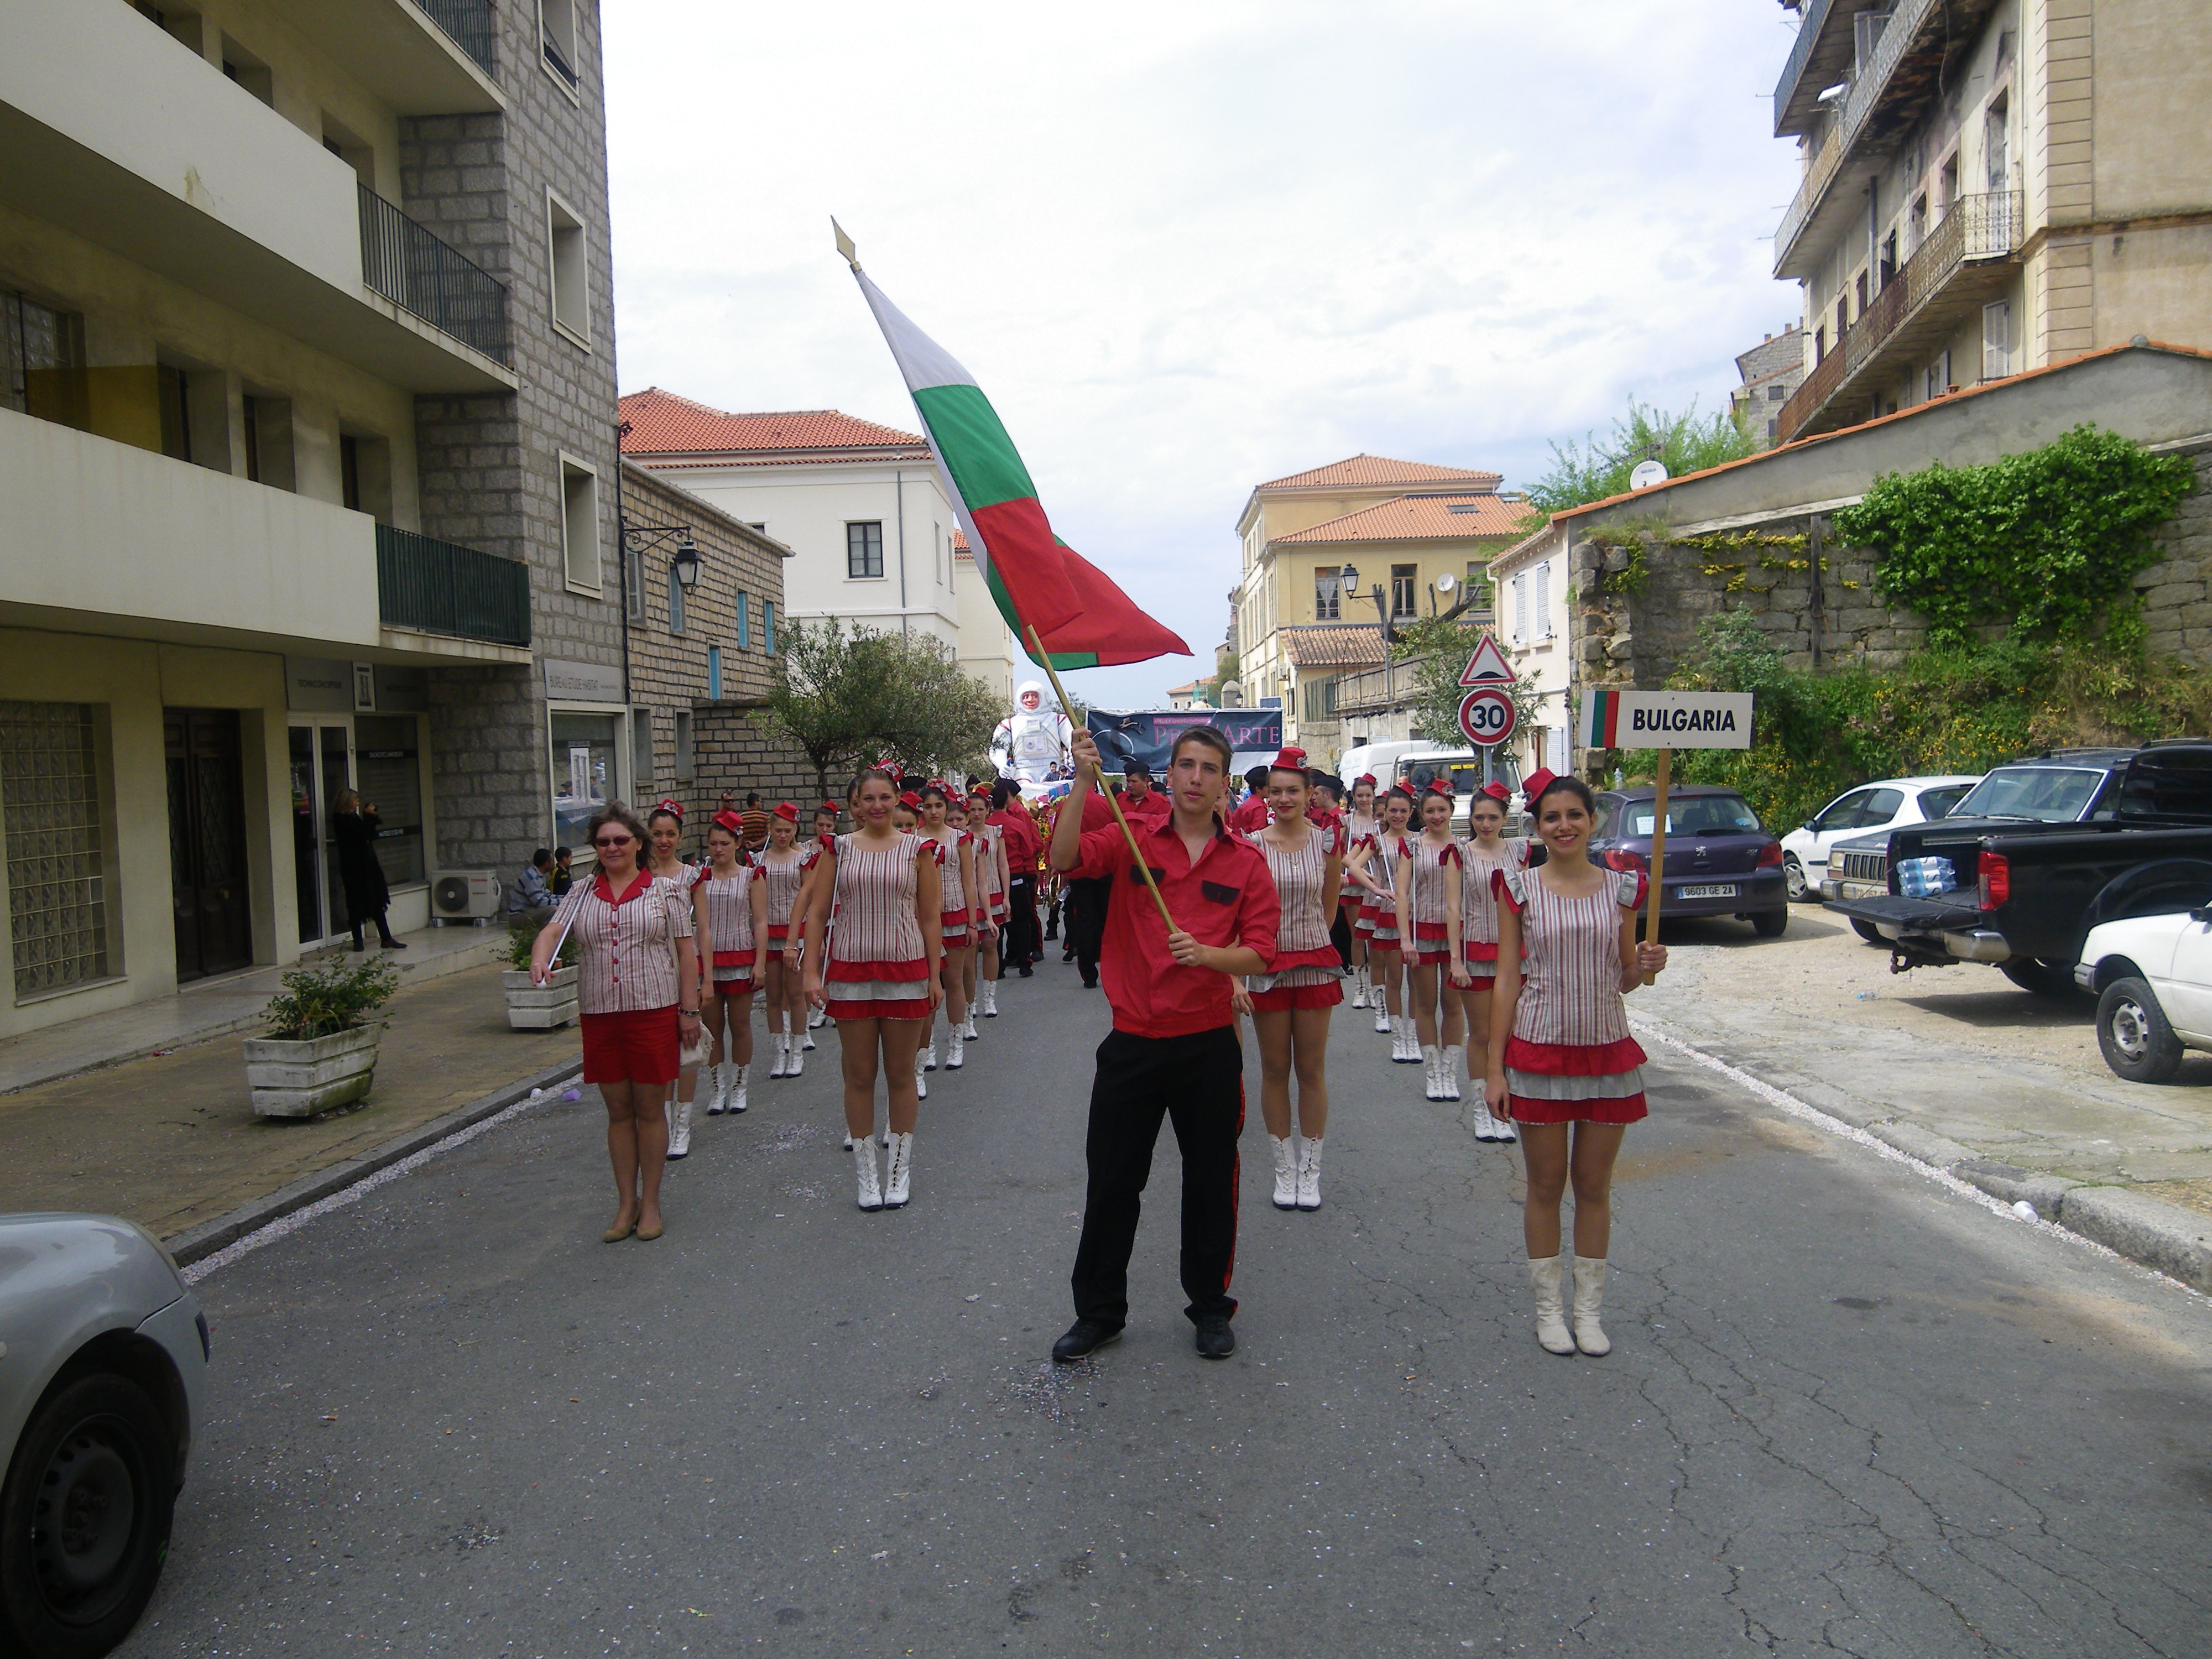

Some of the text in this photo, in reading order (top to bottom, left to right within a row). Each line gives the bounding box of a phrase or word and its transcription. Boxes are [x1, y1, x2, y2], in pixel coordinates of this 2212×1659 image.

[1472, 705, 1505, 729] 30
[1632, 709, 1735, 731] BULGARIA
[1685, 886, 1733, 895] 9603 GE 2A
